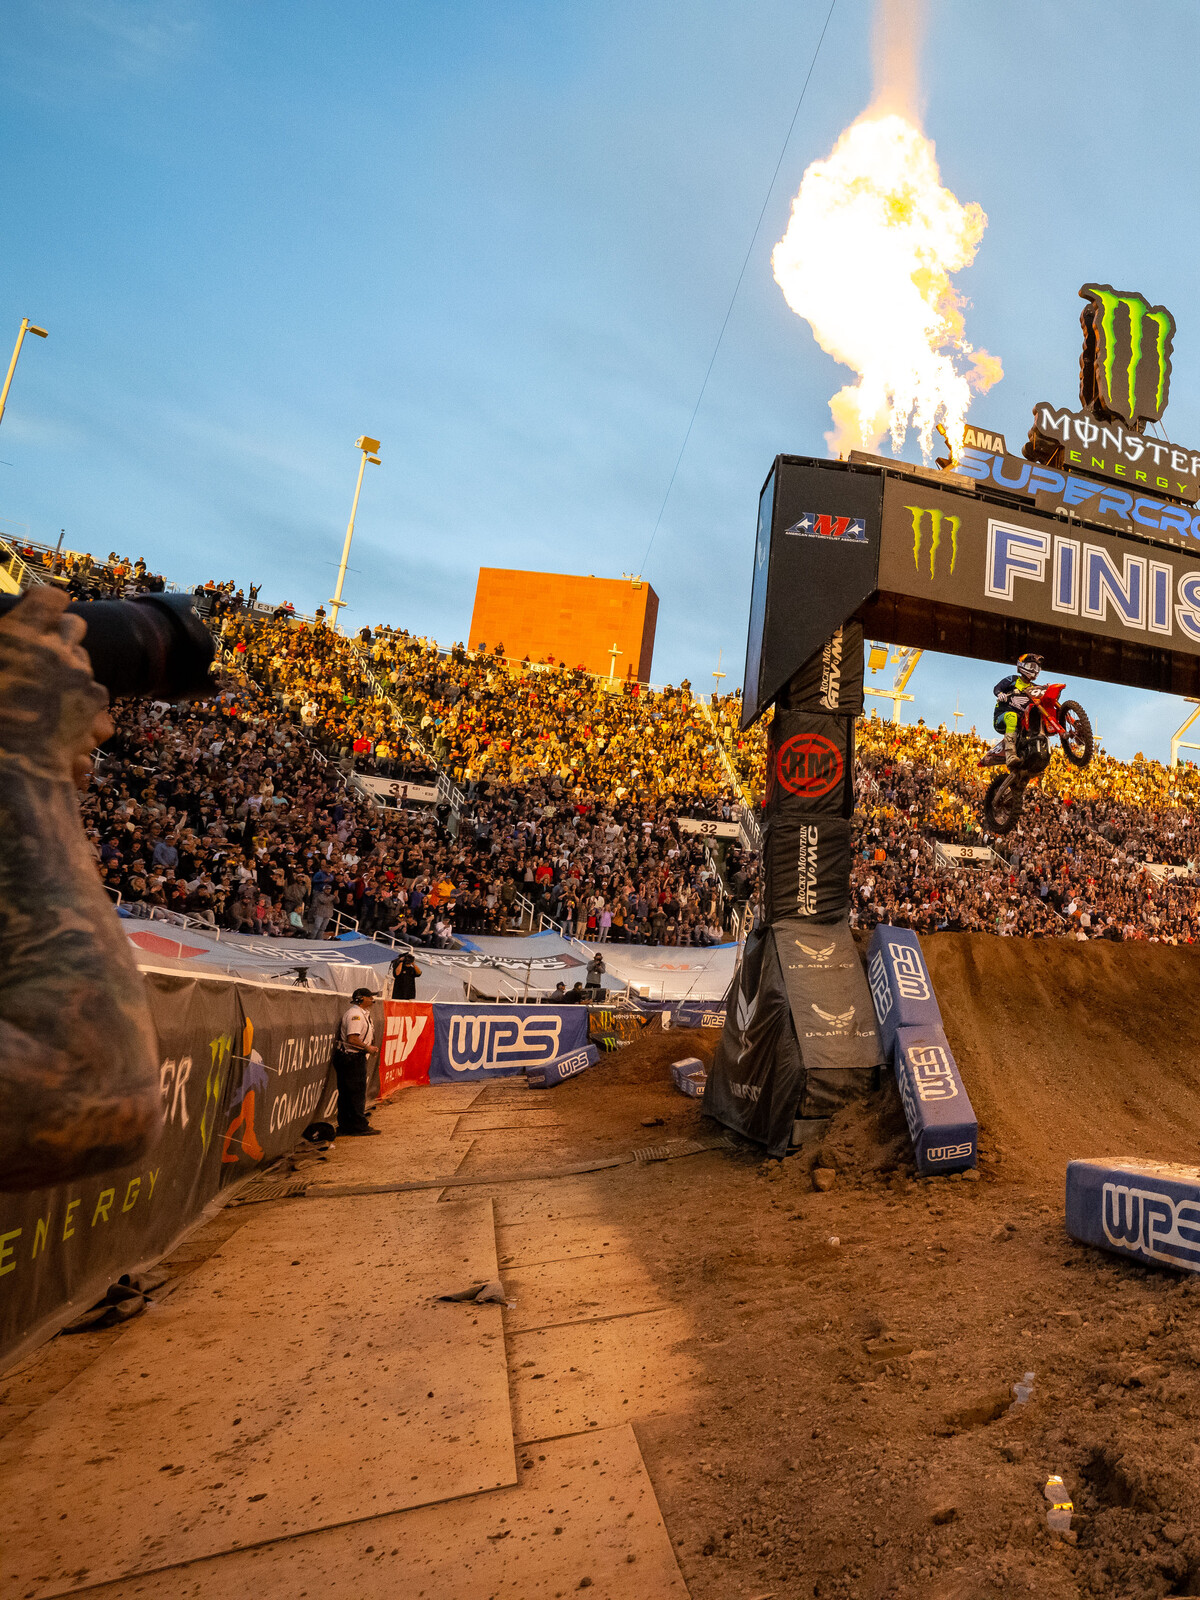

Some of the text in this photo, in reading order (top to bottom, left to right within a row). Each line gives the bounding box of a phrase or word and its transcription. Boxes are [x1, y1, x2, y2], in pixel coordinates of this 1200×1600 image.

[963, 434, 1004, 454] AMA
[1069, 450, 1188, 494] ENERGY
[785, 512, 869, 540] AMA
[820, 666, 830, 694] ROCKY
[388, 783, 409, 797] 31
[700, 823, 717, 834] 32
[797, 824, 807, 904] ROCKY MOUNTAIN
[960, 848, 973, 857] 33
[888, 943, 930, 1001] WPS
[701, 1014, 726, 1028] WPS
[448, 1015, 563, 1071] WPS
[557, 1051, 589, 1078] WPS
[926, 1142, 972, 1162] WPS
[0, 1168, 160, 1276] ENERGY
